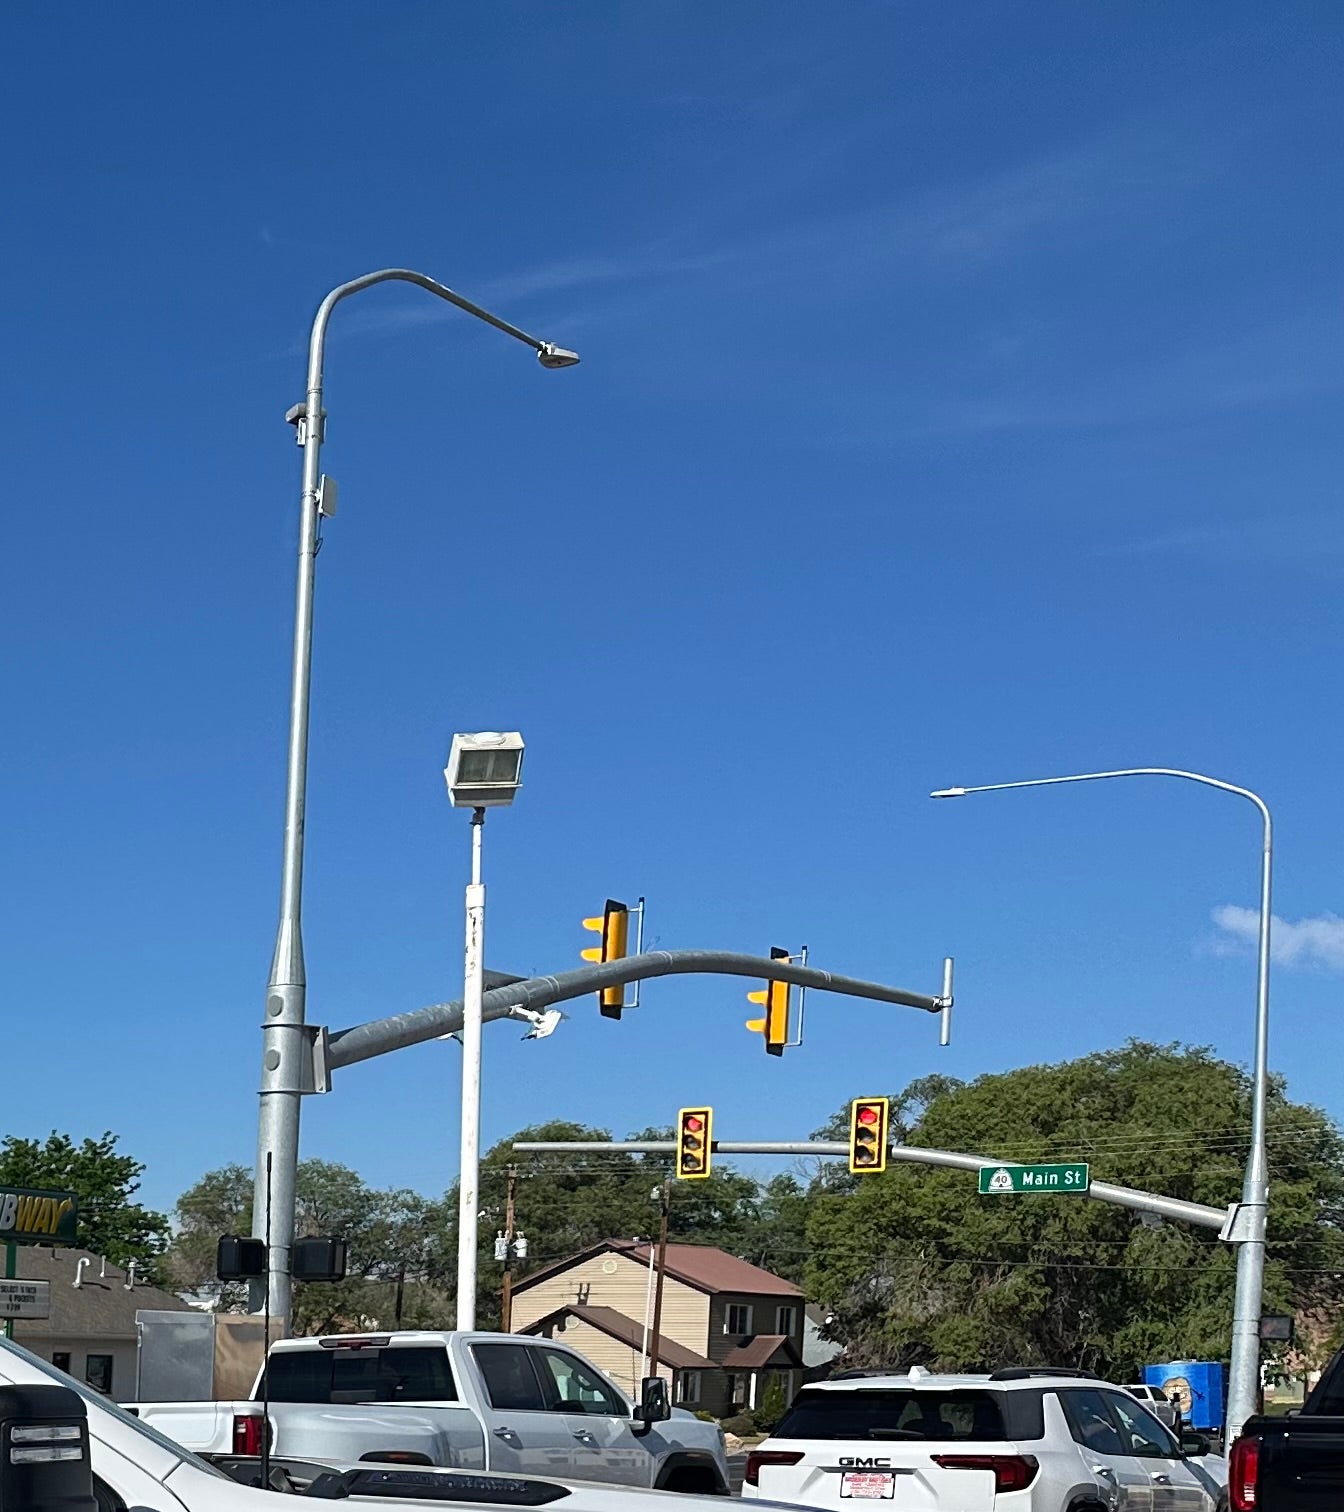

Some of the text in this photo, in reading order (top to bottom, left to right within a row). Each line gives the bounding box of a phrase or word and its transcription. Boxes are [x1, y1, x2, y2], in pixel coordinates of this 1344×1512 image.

[994, 1170, 1081, 1186] 40 Main St
[839, 1456, 891, 1468] GMC
